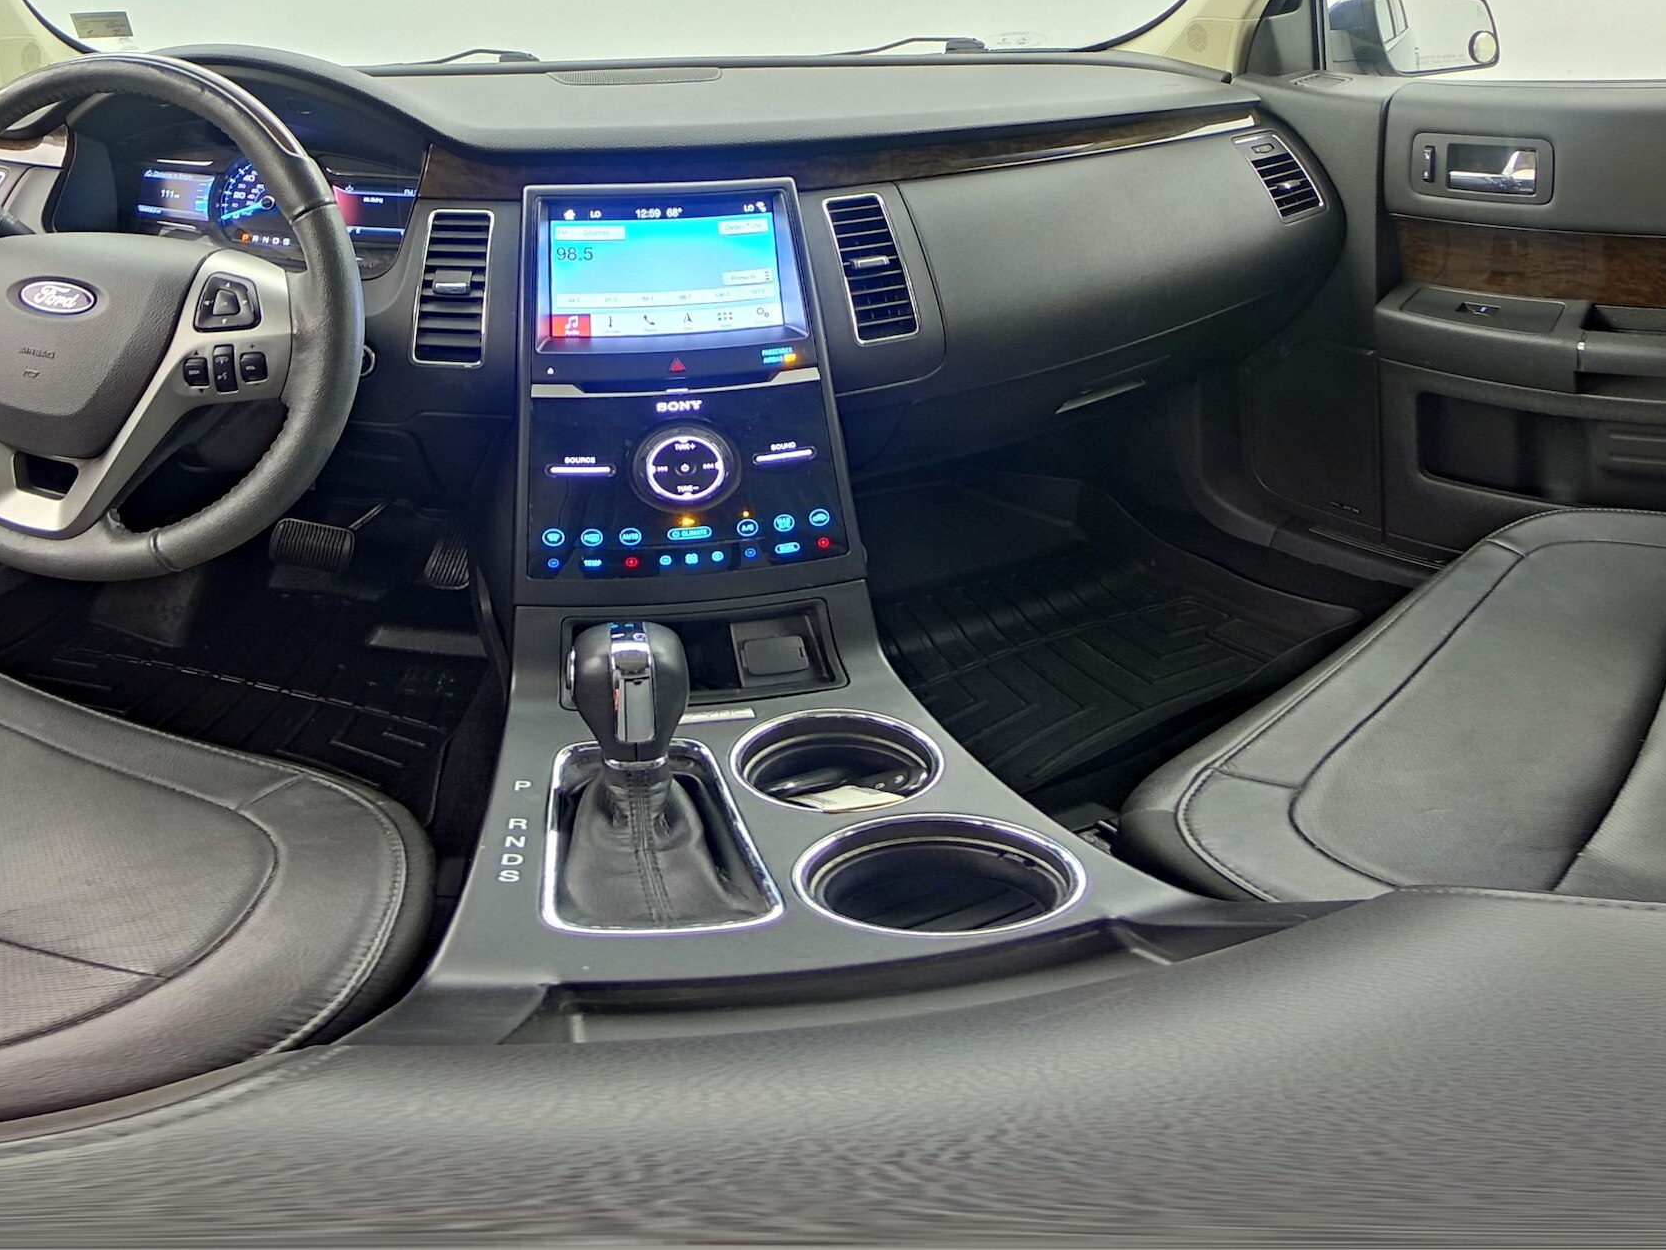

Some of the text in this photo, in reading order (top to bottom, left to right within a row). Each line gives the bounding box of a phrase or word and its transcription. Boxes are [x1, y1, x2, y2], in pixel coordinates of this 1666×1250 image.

[243, 174, 255, 182] 40
[233, 191, 246, 199] 20
[590, 210, 602, 218] LO
[666, 207, 683, 218] 68°
[743, 204, 755, 213] LO
[252, 235, 259, 243] R
[262, 236, 270, 244] N
[272, 237, 280, 245] D
[283, 238, 290, 246] S
[556, 246, 594, 262] 98.5
[34, 285, 79, 309] Ford
[656, 400, 702, 413] SONY
[770, 440, 797, 451] SOUND
[564, 455, 597, 464] SOURCE
[622, 532, 639, 541] AUTO
[583, 559, 602, 568] TEMP
[514, 780, 531, 791] P
[508, 818, 528, 830] R
[504, 835, 526, 848] N
[501, 853, 524, 866] D
[498, 870, 520, 882] S
